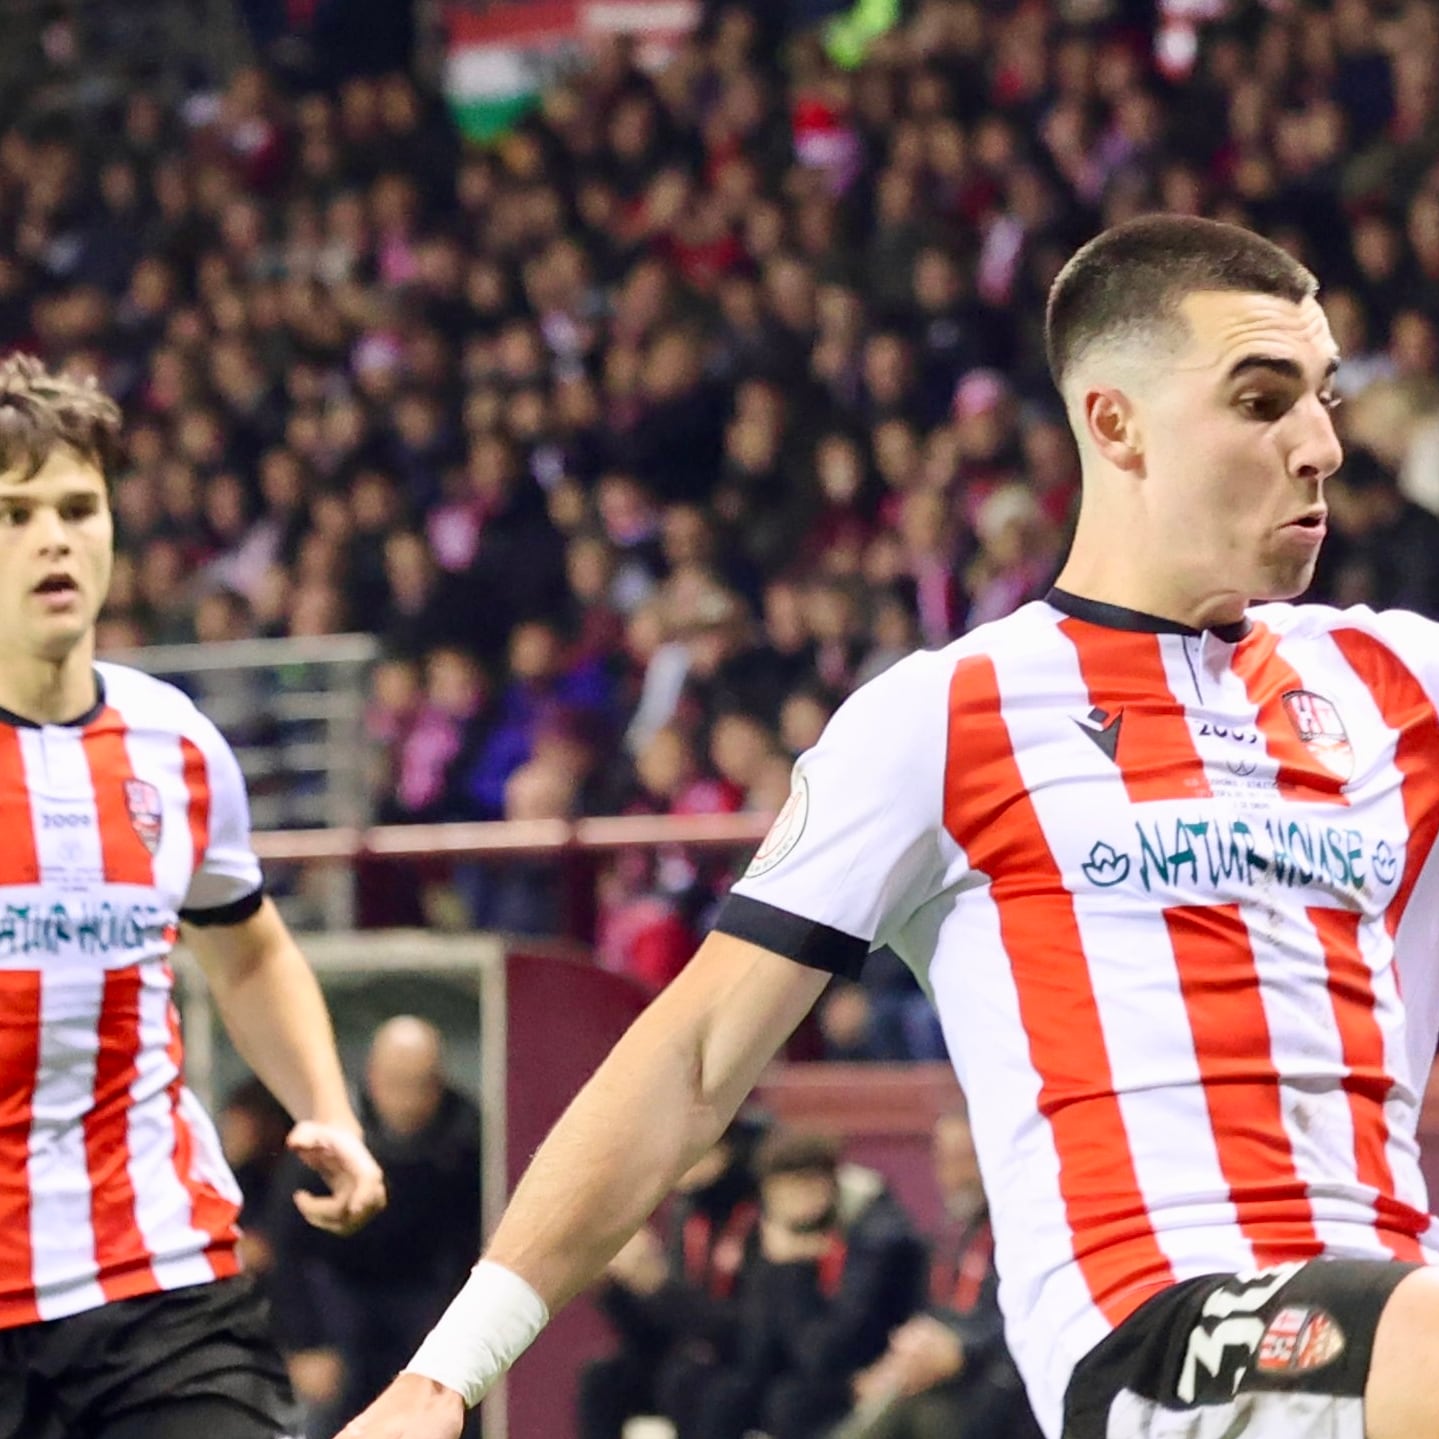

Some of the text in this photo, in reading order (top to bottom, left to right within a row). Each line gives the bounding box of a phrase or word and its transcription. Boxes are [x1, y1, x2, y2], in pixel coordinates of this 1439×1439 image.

[1135, 817, 1366, 892] NATUR HOUSE
[0, 903, 70, 954] ATUR
